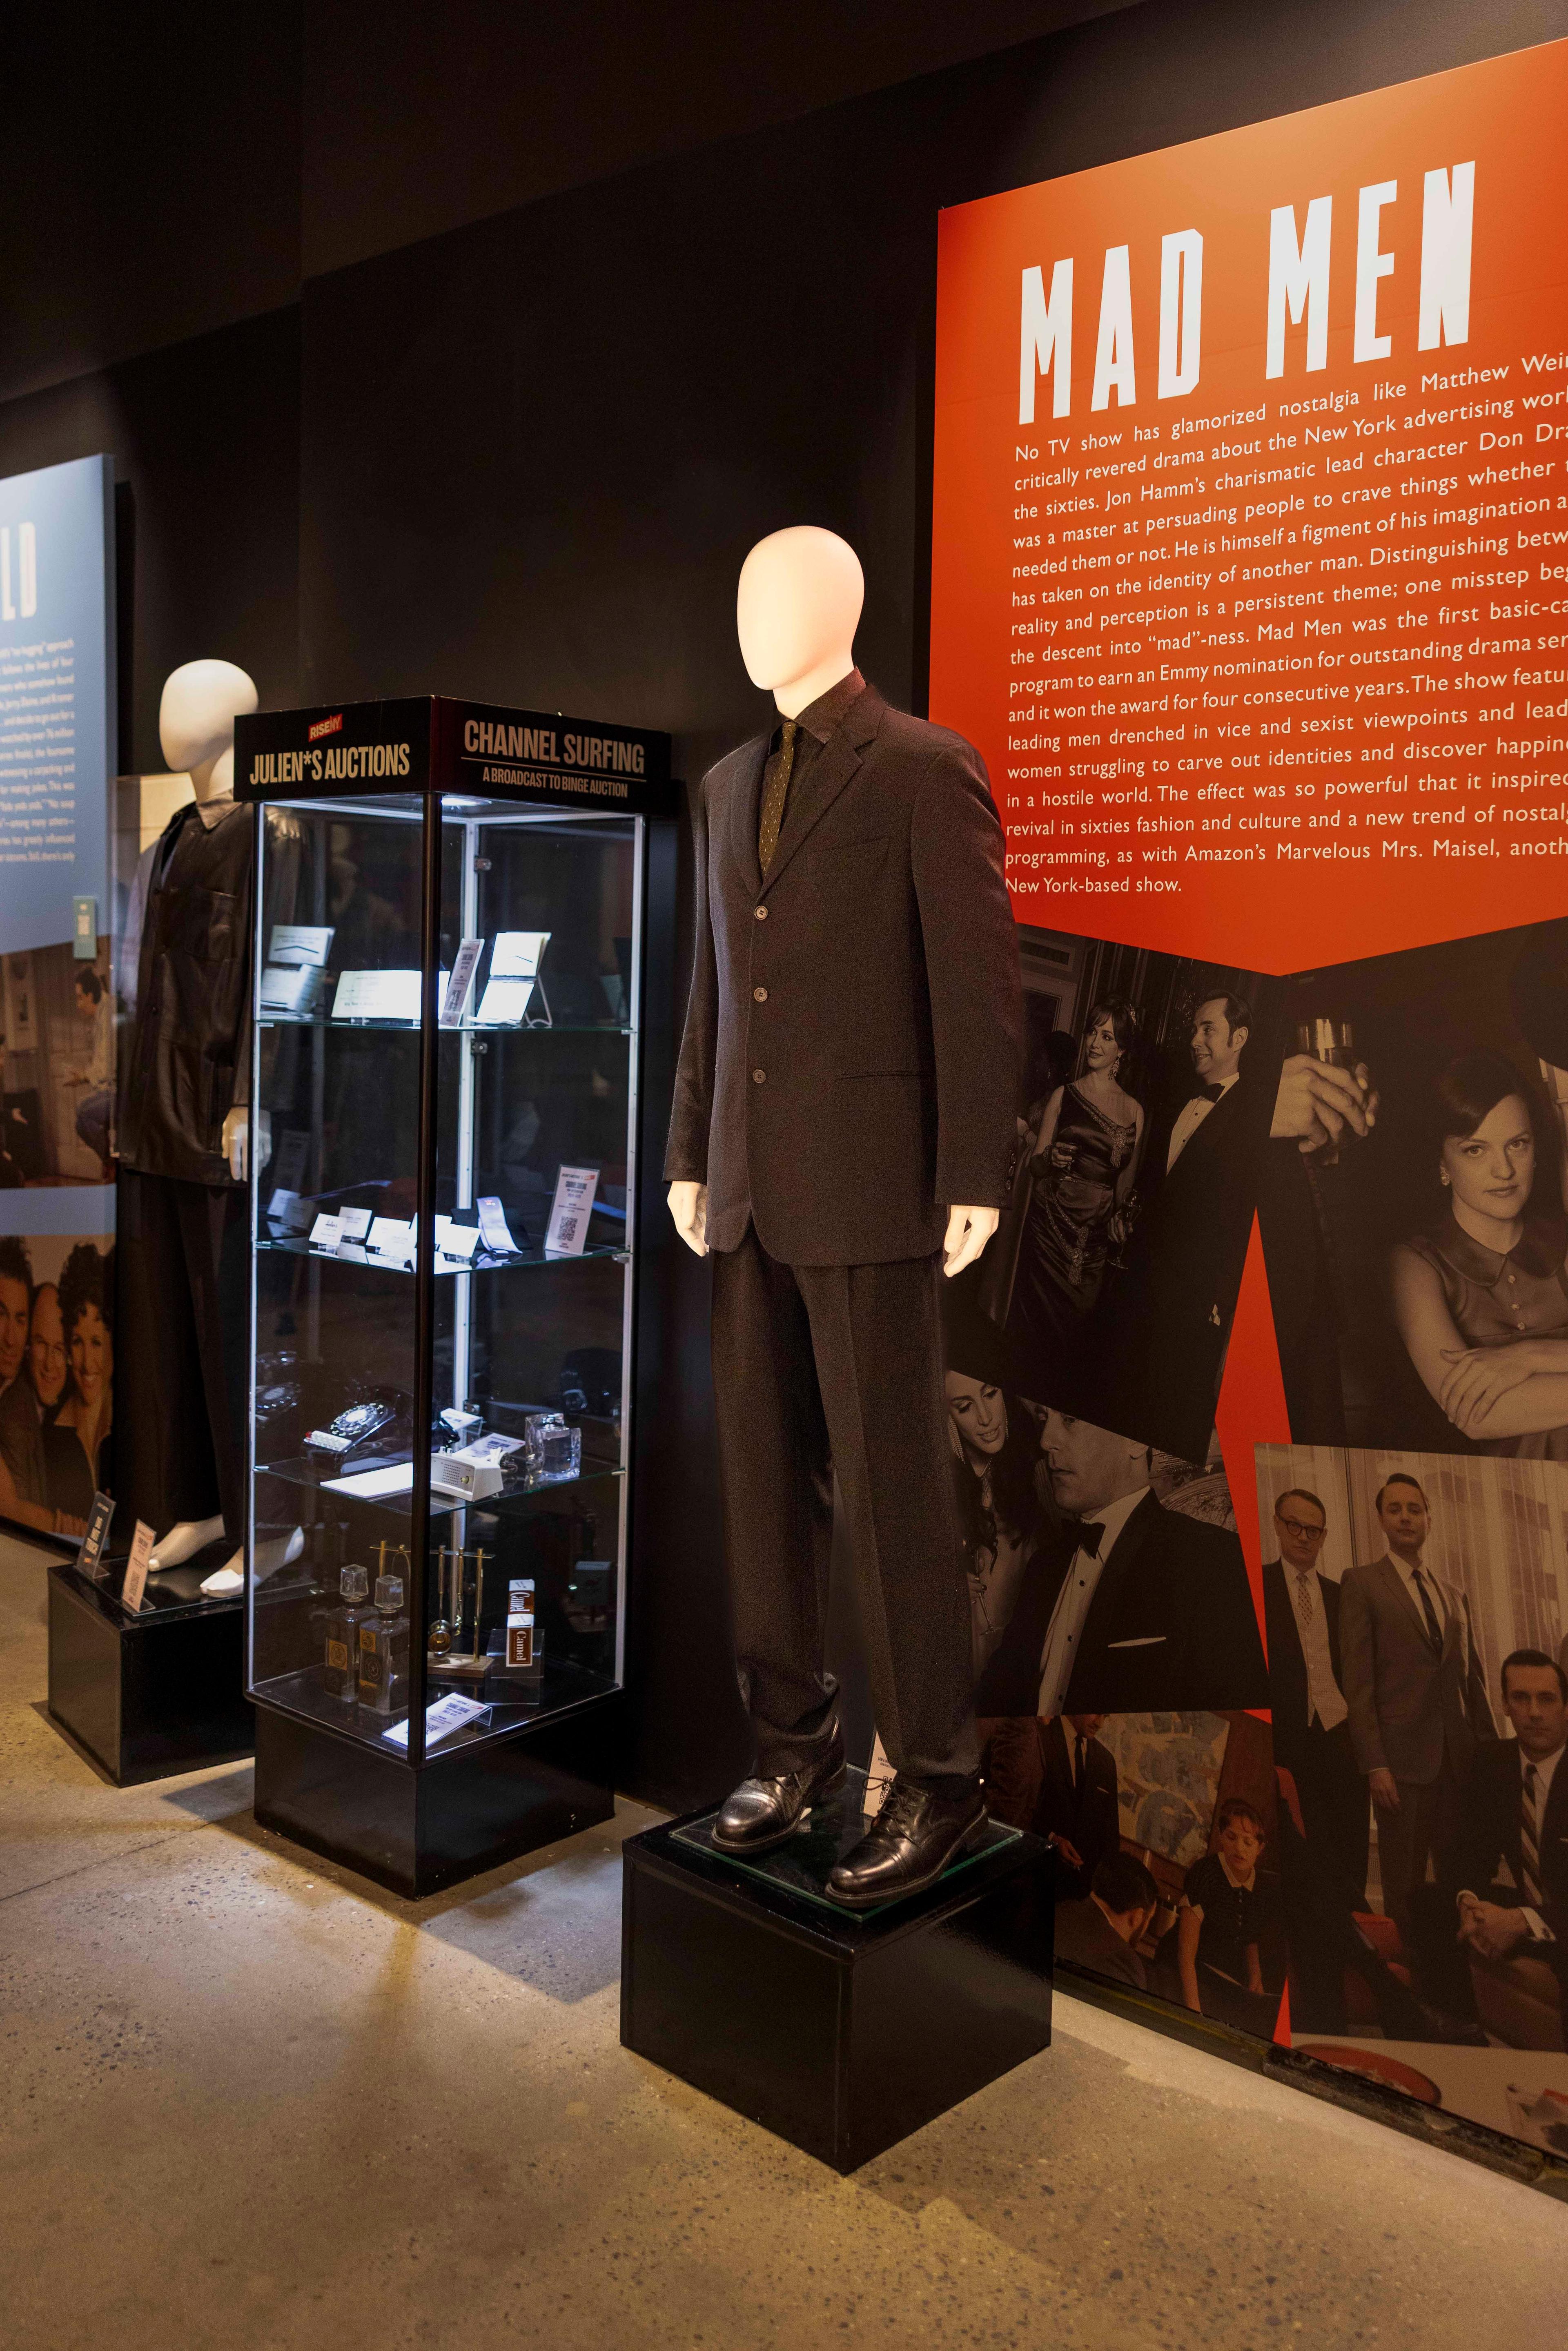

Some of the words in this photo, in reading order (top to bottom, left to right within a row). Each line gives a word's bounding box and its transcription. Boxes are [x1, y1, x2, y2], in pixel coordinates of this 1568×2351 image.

[1019, 228, 1204, 426] MAD
[1265, 160, 1475, 380] MEN
[1016, 445, 1039, 461] No
[1048, 437, 1070, 456] TV
[1081, 433, 1123, 451] show
[1134, 426, 1160, 442] has
[1171, 403, 1266, 440] glamorized
[1280, 390, 1359, 417] nostalgia
[1374, 381, 1406, 401] like
[1421, 366, 1509, 393] Matthew
[1015, 467, 1079, 490] critically
[1086, 455, 1146, 480] revered
[1153, 450, 1205, 468] drama
[1212, 440, 1261, 460] about
[1268, 432, 1296, 450] the
[1305, 426, 1348, 445] New
[1352, 414, 1396, 437] York
[1404, 399, 1514, 429] advertising
[1014, 504, 1038, 520] the
[1046, 496, 1099, 515] sixties.
[1105, 490, 1131, 511] Jon
[1215, 462, 1315, 490] charismatic
[1326, 452, 1363, 474] lead
[1374, 441, 1468, 466] character
[1480, 432, 1523, 451] Don
[1013, 535, 1040, 548] was
[1063, 524, 1116, 542] master
[1123, 520, 1139, 534] at
[1146, 506, 1237, 536] persuading
[1245, 495, 1305, 522] people
[1342, 486, 1391, 504] crave
[1400, 477, 1458, 496] things
[1468, 461, 1555, 486] whether
[1013, 556, 1067, 578] needed
[1071, 554, 1111, 570] them
[1116, 552, 1134, 565] or
[1139, 547, 1171, 562] not.
[1175, 540, 1198, 557] He
[1221, 527, 1284, 552] himself
[1302, 520, 1371, 545] figment
[1376, 513, 1396, 532] of
[1401, 511, 1427, 529] his
[1434, 497, 1550, 525] imagination
[1012, 592, 1035, 606] has
[1042, 586, 1082, 603] taken
[1089, 585, 1109, 598] on
[1116, 578, 1141, 595] the
[1149, 571, 1212, 591] identity
[1219, 565, 1237, 583] of
[1242, 559, 1313, 580] another
[1321, 556, 1363, 571] man.
[1370, 536, 1508, 566] Distinguishing
[1012, 618, 1058, 636] reality
[1066, 612, 1092, 630] and
[1100, 605, 1188, 631] perception
[1235, 591, 1324, 617] persistent
[1333, 584, 1397, 602] theme;
[1405, 579, 1441, 594] one
[1452, 570, 1529, 589] misstep
[1011, 649, 1034, 664] the
[1042, 644, 1102, 661] descent
[1110, 640, 1141, 655] into
[1258, 622, 1293, 641] Mad
[1304, 619, 1341, 637] Men
[1352, 618, 1386, 632] was
[1397, 610, 1428, 628] the
[1439, 606, 1479, 624] first
[1010, 677, 1073, 698] program
[1078, 675, 1094, 687] to
[1098, 673, 1132, 686] earn
[1137, 671, 1155, 682] an
[1160, 664, 1209, 682] Emmy
[1214, 655, 1312, 676] nomination
[1318, 651, 1345, 667] for
[1350, 641, 1463, 665] outstanding
[1468, 637, 1531, 655] drama
[1009, 705, 1034, 722] and
[1054, 706, 1085, 718] won
[1091, 700, 1116, 716] the
[1120, 695, 1168, 714] award
[1173, 693, 1198, 710] for
[1203, 691, 1238, 708] four
[1243, 684, 1349, 705] consecutive
[1411, 675, 1448, 692] The
[1454, 672, 1507, 690] show
[464, 720, 560, 762] CHANNEL
[564, 733, 644, 774] SURFING
[1009, 734, 1060, 752] leading
[1069, 734, 1100, 747] men
[1109, 724, 1184, 744] drenched
[1217, 722, 1251, 738] vice
[1260, 717, 1291, 735] and
[1301, 715, 1354, 732] sexist
[1363, 709, 1468, 731] viewpoints
[1479, 702, 1514, 722] and
[1527, 699, 1568, 718] lead
[325, 743, 410, 779] AUCTIONS
[483, 767, 490, 782] A
[491, 768, 547, 789] BROADCAST
[548, 774, 560, 790] TO
[562, 776, 589, 793] BINGE
[590, 780, 628, 798] AUCTION
[1008, 766, 1061, 778] women
[1069, 758, 1145, 779] struggling
[1152, 760, 1169, 772] to
[1178, 758, 1223, 770] carve
[1231, 754, 1260, 768] out
[1269, 747, 1352, 766] identities
[1361, 743, 1394, 761] and
[1404, 742, 1487, 759] discover
[1043, 789, 1094, 806] hostile
[1102, 787, 1152, 804] world.
[1157, 785, 1188, 801] The
[1197, 783, 1245, 800] effect
[1253, 785, 1285, 798] was
[1295, 784, 1315, 796] so
[1325, 775, 1408, 800] powerful
[1418, 774, 1457, 791] that
[1007, 820, 1054, 836] revival
[1081, 819, 1129, 834] sixties
[1137, 816, 1194, 832] fashion
[1202, 813, 1231, 830] and
[1239, 812, 1301, 829] culture
[1309, 810, 1340, 827] and
[1366, 813, 1404, 825] new
[1412, 806, 1465, 824] trend
[1474, 804, 1495, 822] of
[1006, 849, 1109, 869] programming,
[1117, 851, 1132, 862] as
[1142, 846, 1177, 862] with
[1277, 842, 1370, 859] Marvelous
[1383, 840, 1423, 857] Mrs.
[1434, 838, 1499, 858] Maisel,
[1006, 878, 1040, 893] New
[1043, 876, 1129, 892] York-based
[1136, 876, 1181, 892] show.
[510, 1592, 530, 1612] Camel
[516, 1630, 526, 1661] Camel
